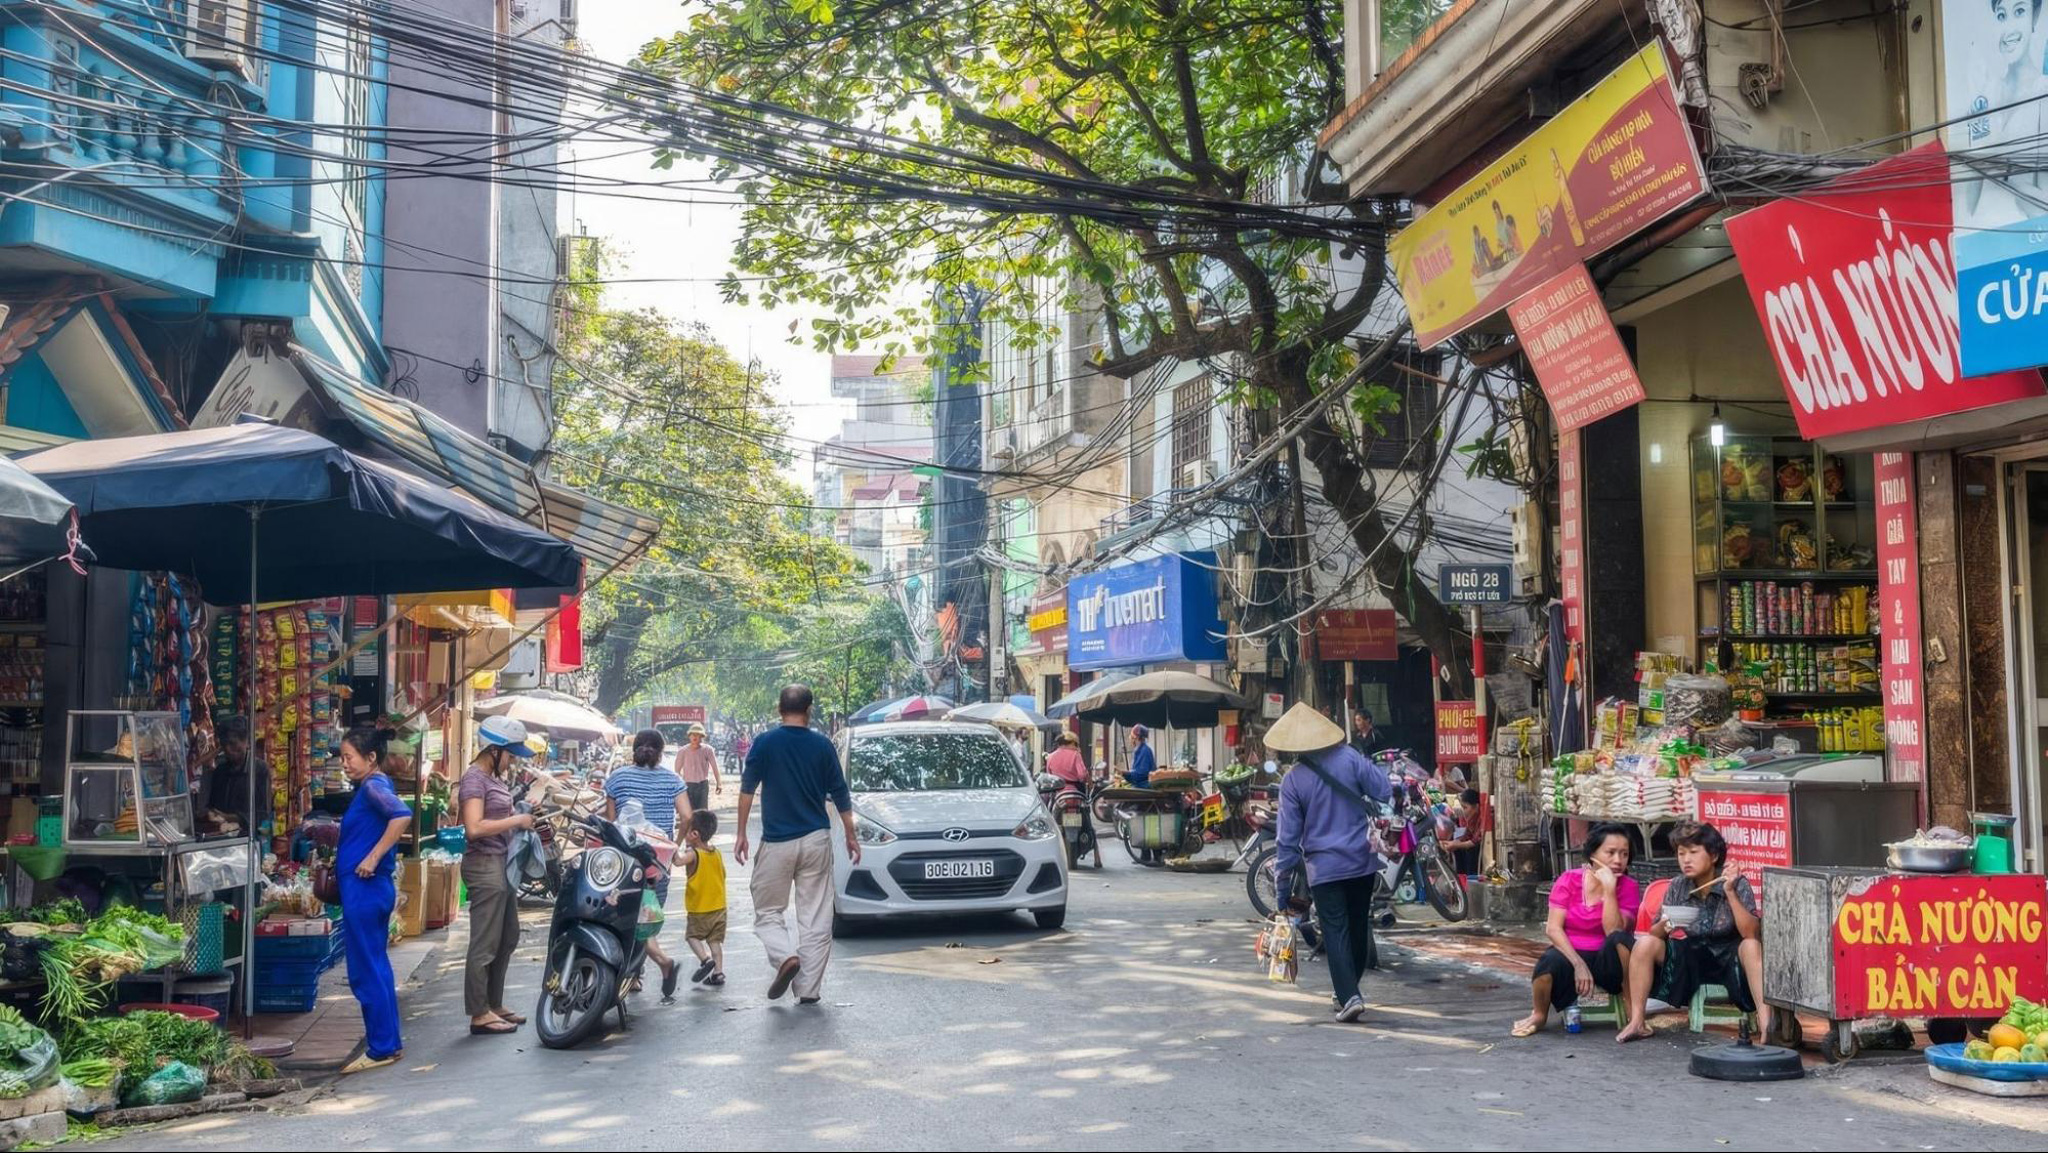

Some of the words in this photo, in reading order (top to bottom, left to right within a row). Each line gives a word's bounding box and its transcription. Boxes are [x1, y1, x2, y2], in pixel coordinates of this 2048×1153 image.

[1764, 224, 1868, 414] CHẢ
[1833, 207, 1962, 397] NƯỚN
[1483, 572, 1499, 587] 28
[1838, 884, 1912, 945] CHẢ
[1919, 888, 2042, 943] NƯỚNG
[1947, 953, 2018, 1009] CÂN
